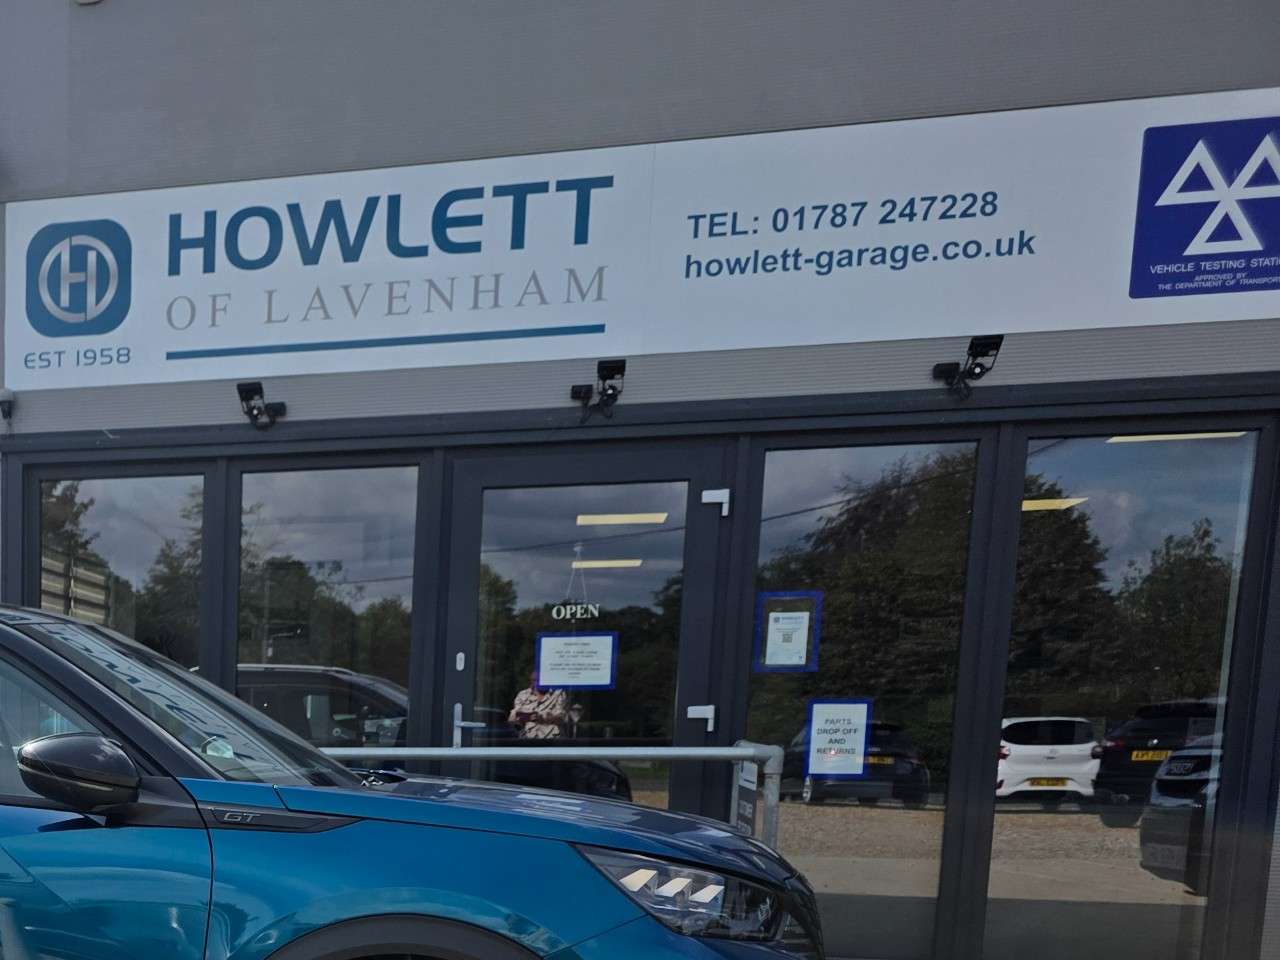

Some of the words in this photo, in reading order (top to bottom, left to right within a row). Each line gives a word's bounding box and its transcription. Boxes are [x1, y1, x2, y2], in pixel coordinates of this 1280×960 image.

[167, 175, 614, 277] HOWLETT
[688, 210, 760, 240] TEL:
[771, 201, 868, 233] 01787
[879, 190, 999, 225] 247228
[684, 230, 1037, 280] howlett-garage.co.uk
[1150, 262, 1195, 274] VEHICLE
[1200, 259, 1245, 271] TESTING
[1175, 280, 1222, 290] DEPARTMENT
[166, 292, 232, 332] OF
[264, 264, 608, 326] LAVENHAM
[24, 350, 66, 371] EST
[75, 347, 132, 368] 1958
[551, 603, 600, 620] OPEN
[828, 737, 846, 745] AND
